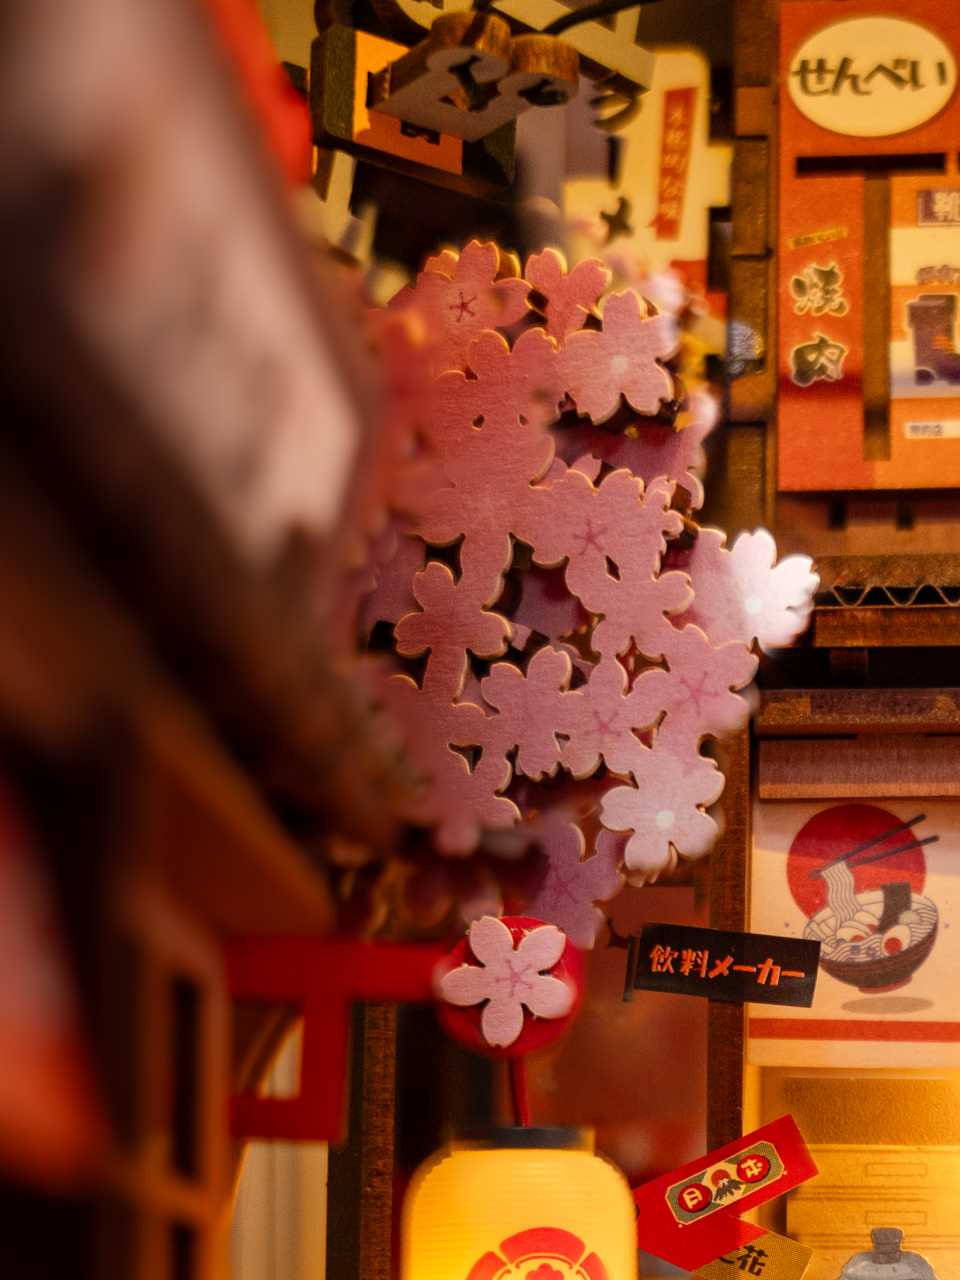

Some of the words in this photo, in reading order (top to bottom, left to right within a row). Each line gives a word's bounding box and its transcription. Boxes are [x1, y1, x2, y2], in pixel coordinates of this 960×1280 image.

[791, 56, 948, 97] せんべい
[649, 944, 806, 987] 飲料メーカー
